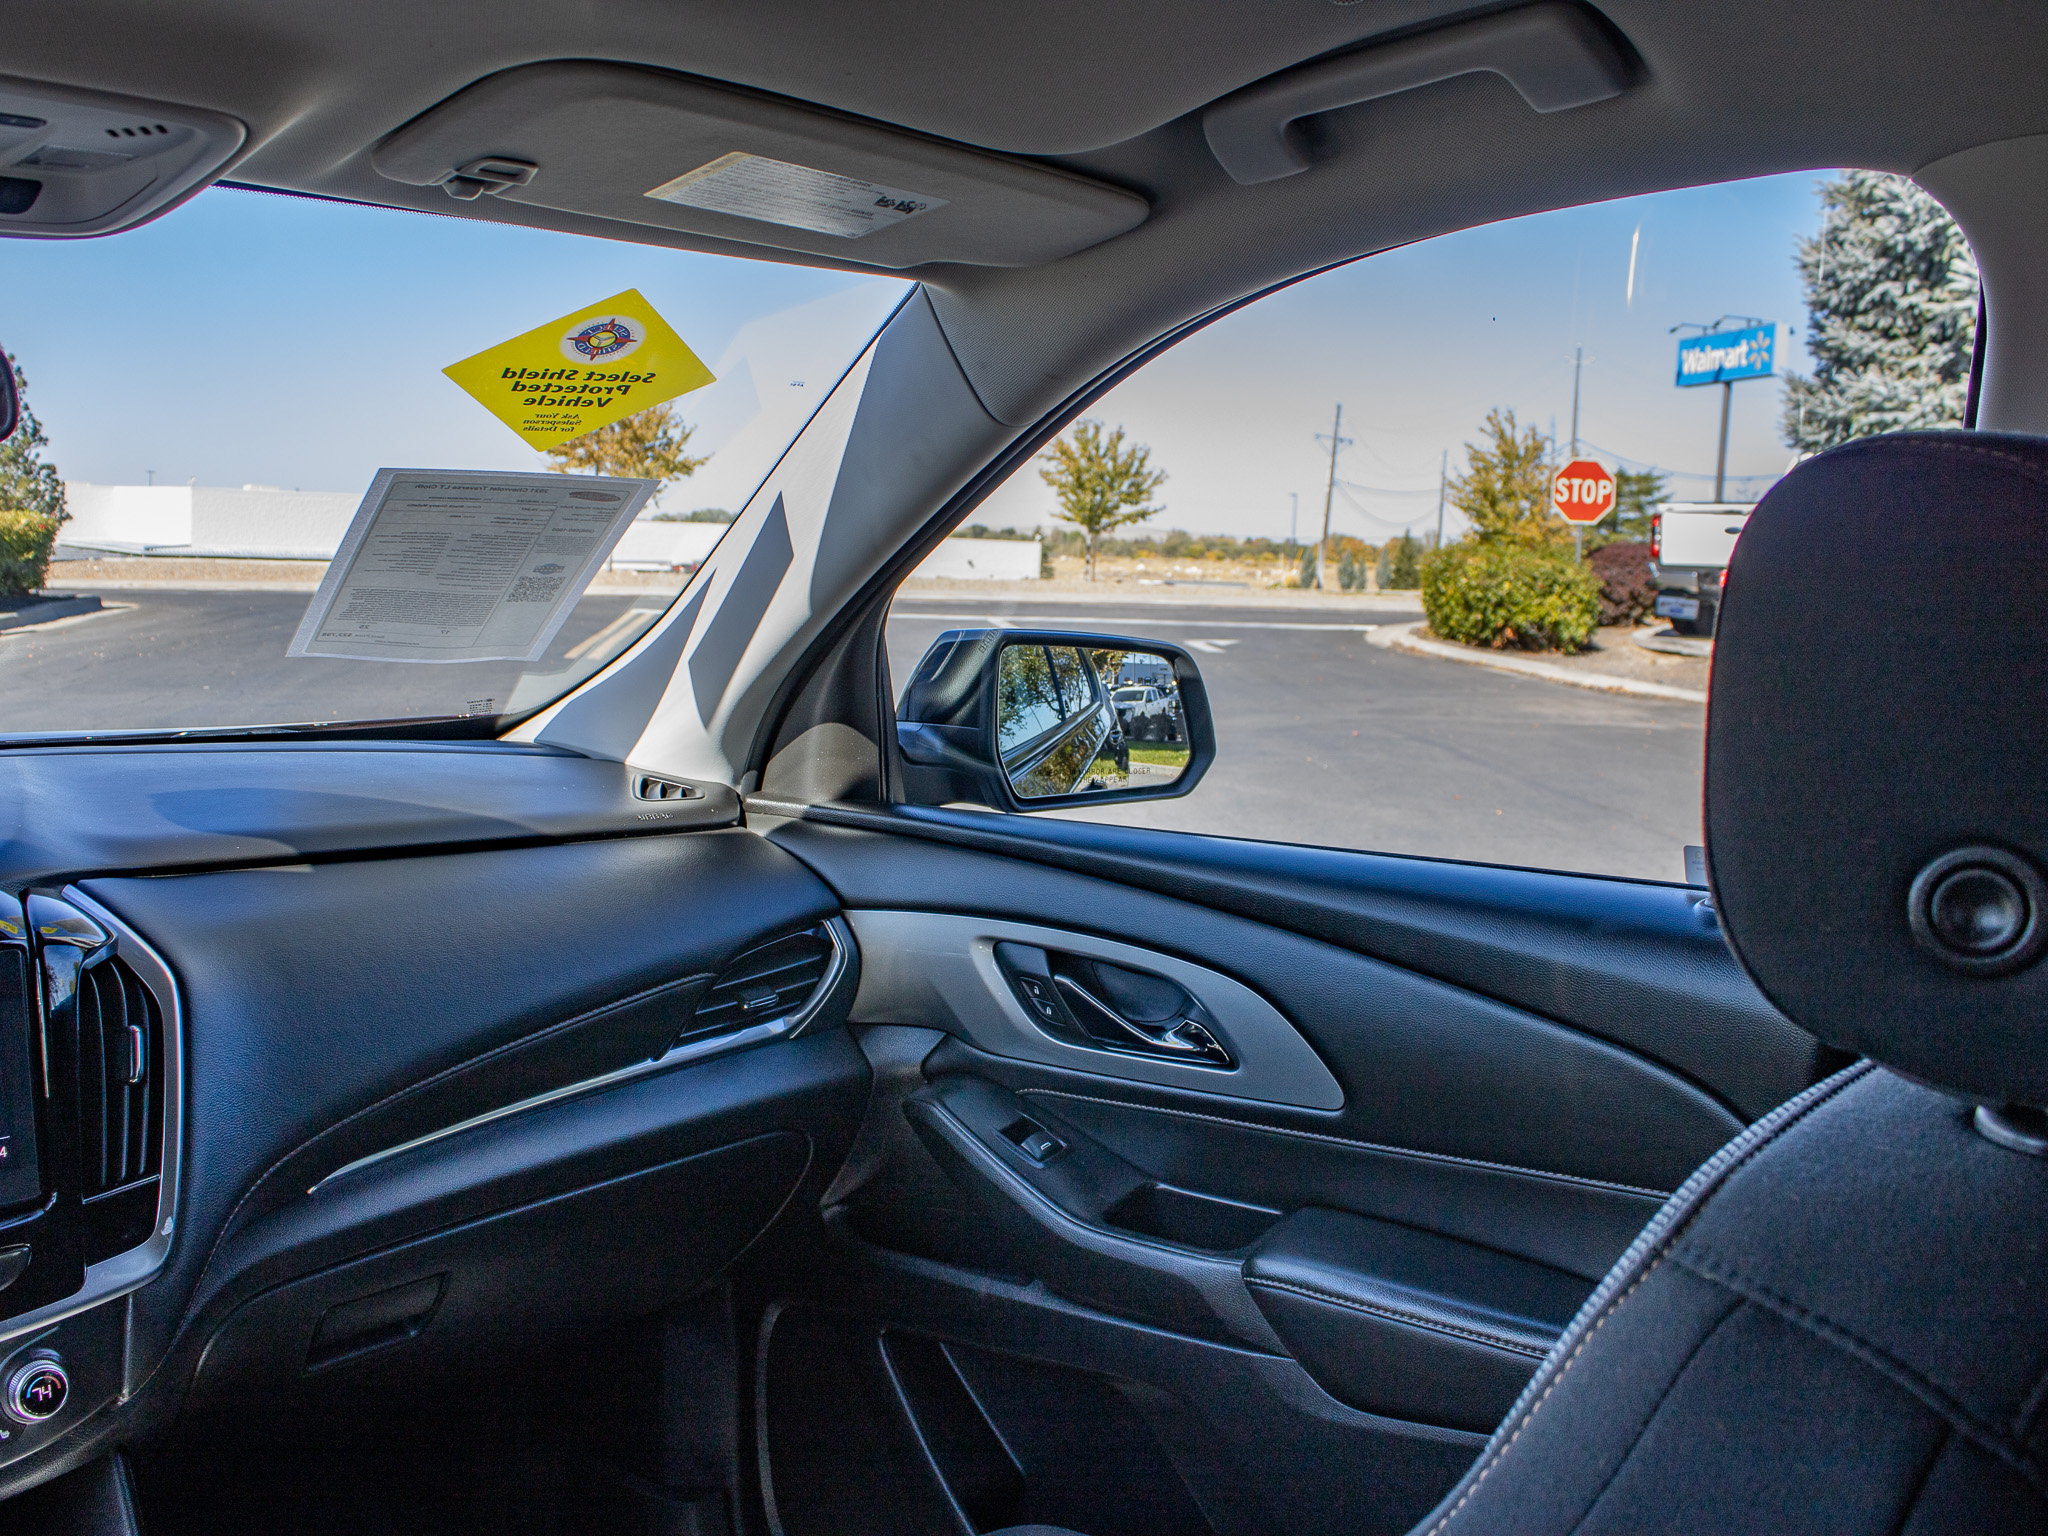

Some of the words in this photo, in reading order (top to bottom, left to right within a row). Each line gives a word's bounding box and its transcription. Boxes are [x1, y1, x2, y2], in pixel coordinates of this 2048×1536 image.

[1682, 339, 1749, 375] Walmart
[1555, 477, 1613, 505] STOP
[31, 1384, 52, 1402] 74
